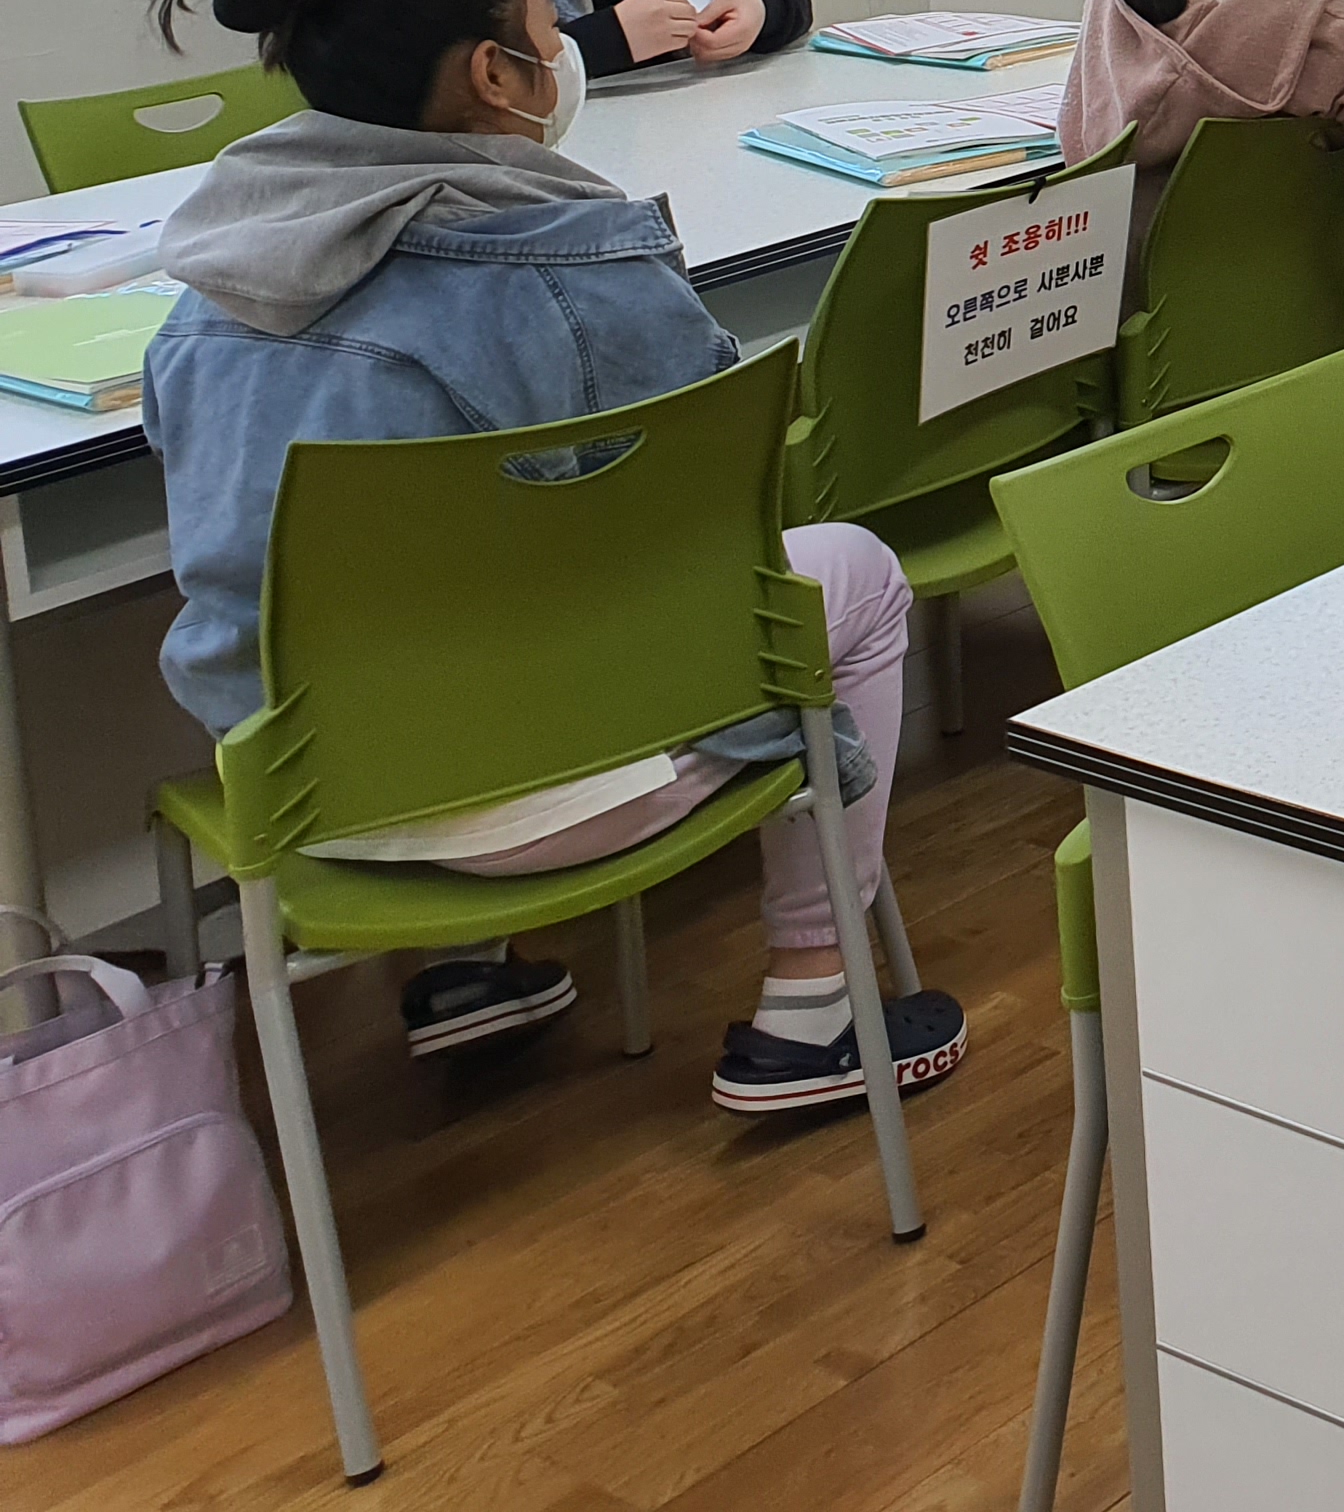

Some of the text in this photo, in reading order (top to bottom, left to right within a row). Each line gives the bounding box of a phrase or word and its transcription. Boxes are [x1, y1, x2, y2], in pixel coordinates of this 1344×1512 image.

[970, 211, 1089, 270] 쉿 조용히!!!
[945, 254, 1105, 329] 오른쪽으로 사뿐사뿐
[964, 305, 1078, 366] 천천히 걸어요
[896, 1042, 961, 1084] rocs
